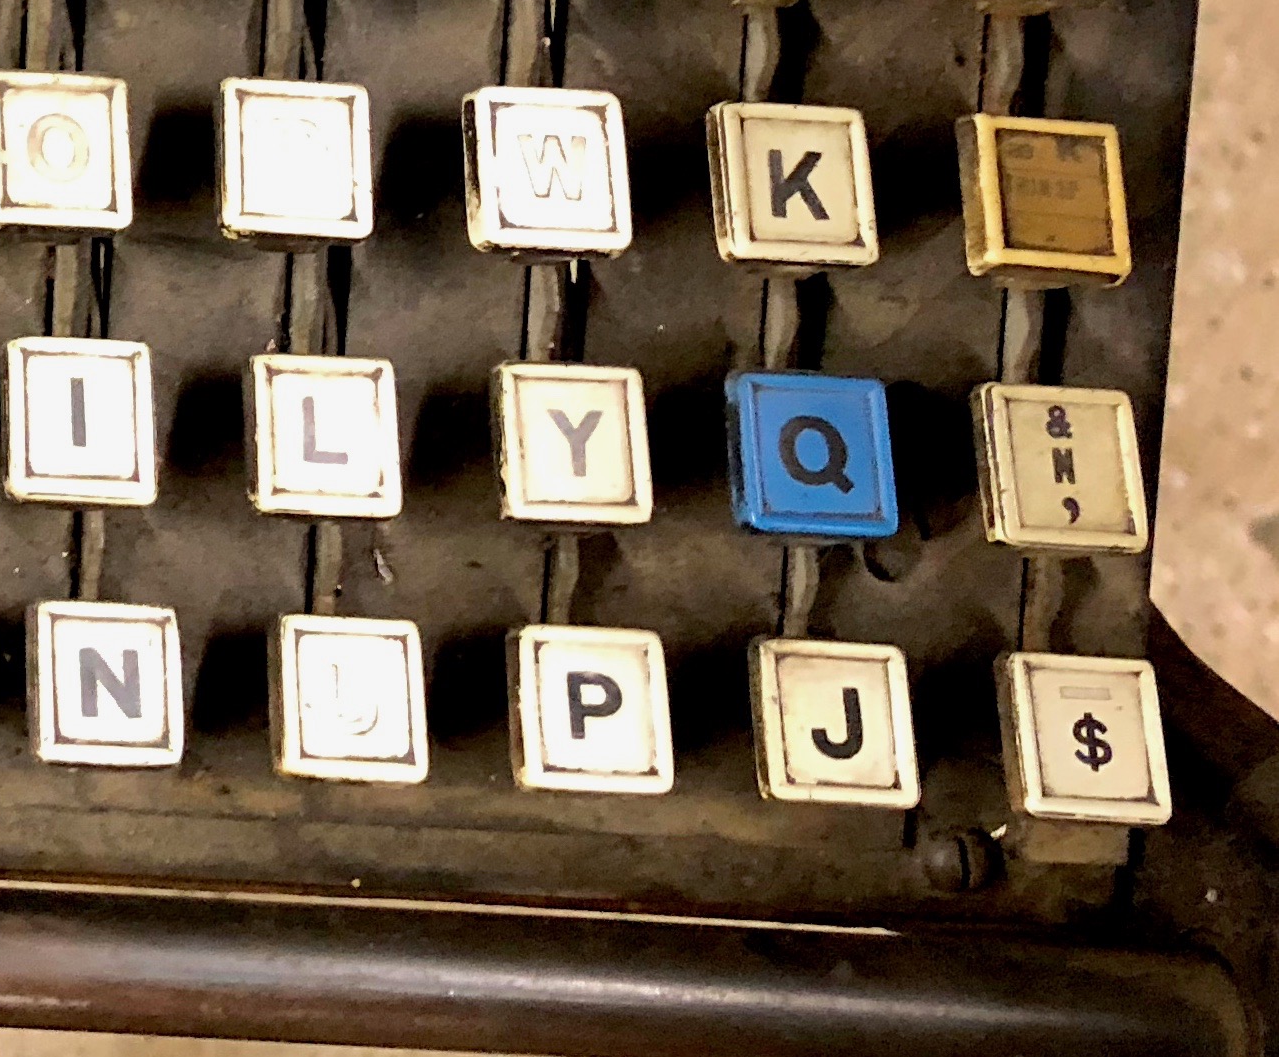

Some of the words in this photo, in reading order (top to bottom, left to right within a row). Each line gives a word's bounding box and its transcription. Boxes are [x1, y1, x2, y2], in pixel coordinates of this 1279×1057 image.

[766, 148, 831, 222] K
[301, 395, 350, 465] L
[547, 408, 605, 477] Y
[777, 414, 856, 495] Q
[1045, 404, 1074, 439] &
[77, 646, 143, 720] N
[565, 670, 624, 741] P
[809, 686, 863, 761] J
[1071, 711, 1114, 772] $
